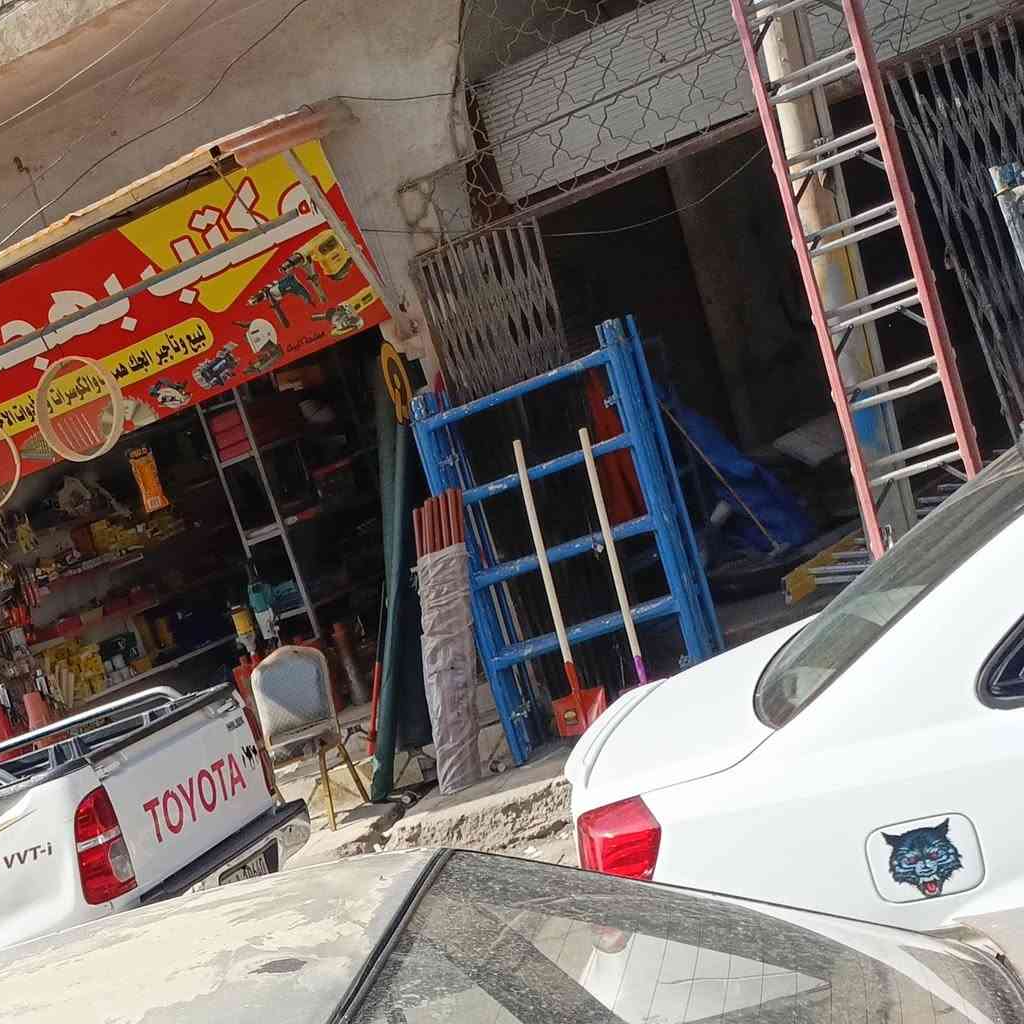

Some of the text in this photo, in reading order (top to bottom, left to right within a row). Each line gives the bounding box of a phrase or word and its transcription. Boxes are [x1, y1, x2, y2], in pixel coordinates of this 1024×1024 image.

[185, 323, 206, 352] لبيع
[144, 752, 246, 843] TOYOTA
[6, 842, 52, 869] VVT-i
